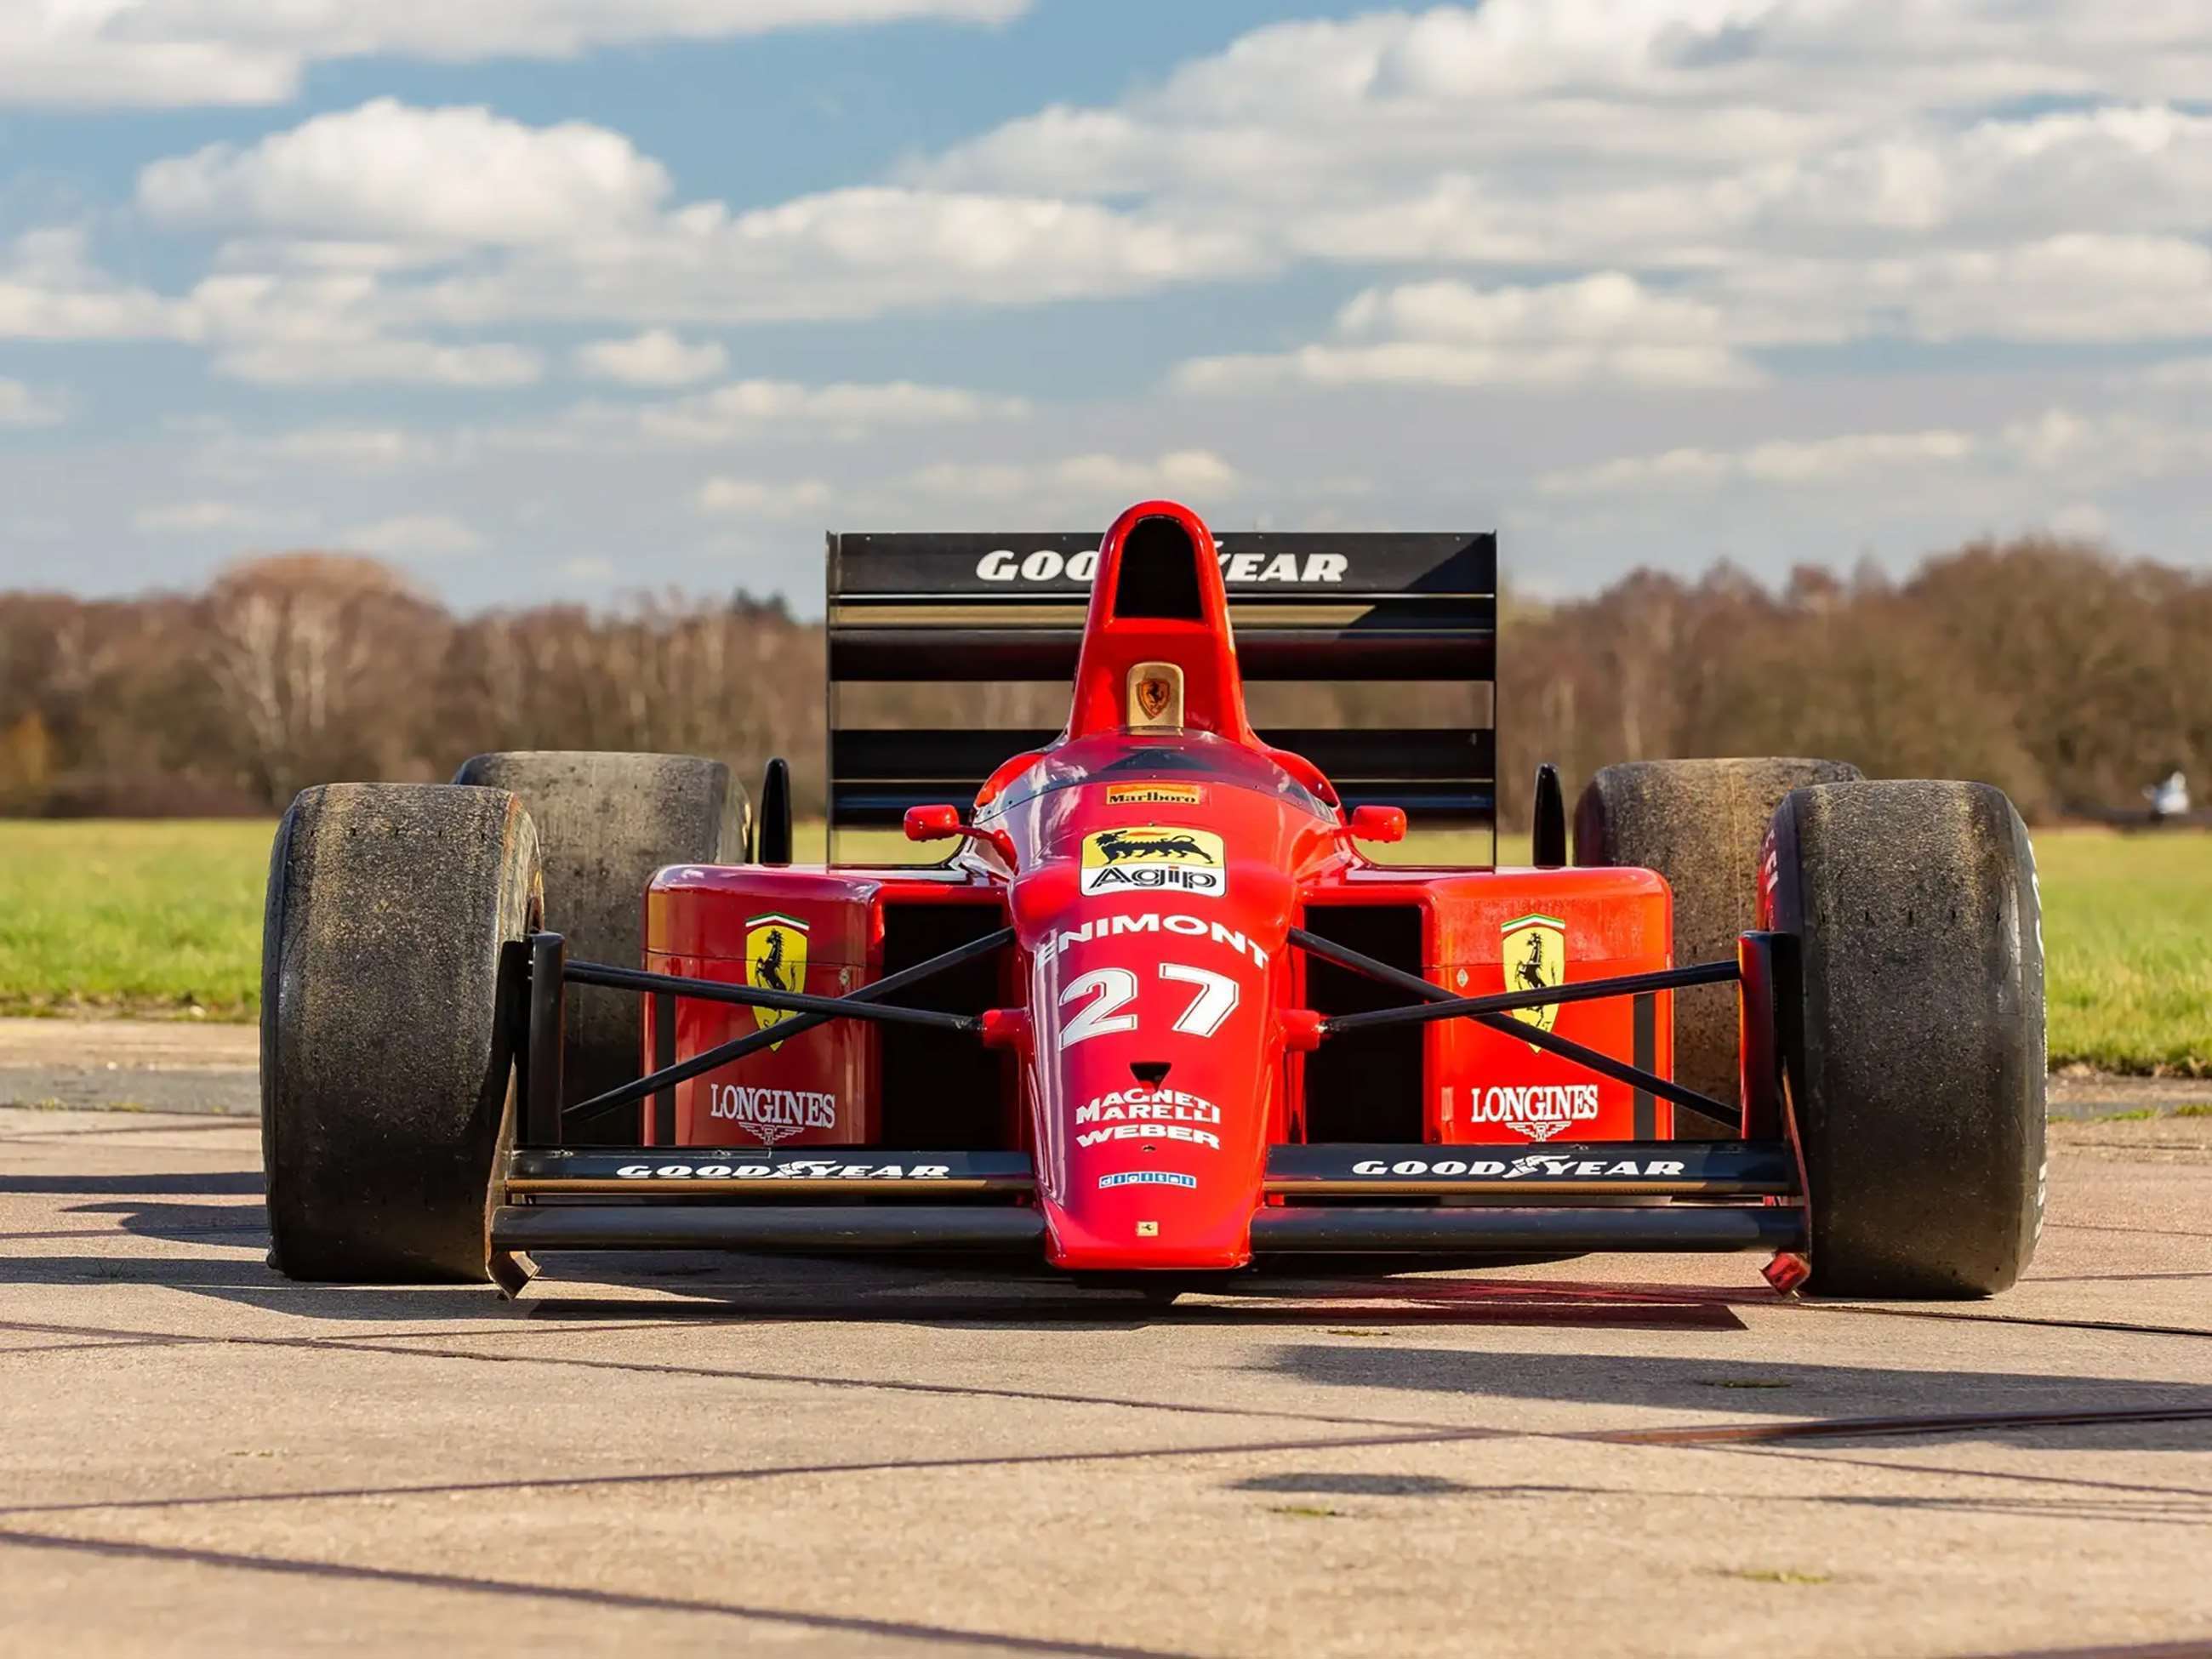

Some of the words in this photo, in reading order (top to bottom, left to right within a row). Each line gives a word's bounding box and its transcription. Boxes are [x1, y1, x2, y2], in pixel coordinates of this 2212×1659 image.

[1109, 792, 1196, 803] Marlboro
[1090, 866, 1217, 889] Agip
[1037, 913, 1268, 971] ENIMONT
[1058, 962, 1240, 1051] 27
[710, 1083, 835, 1128] LONGINES
[1471, 1085, 1598, 1123] LONGINES
[1075, 1124, 1220, 1150] WEBER
[616, 1163, 950, 1179] GOODYEAR
[1352, 1157, 1685, 1177] GOODYEAR
